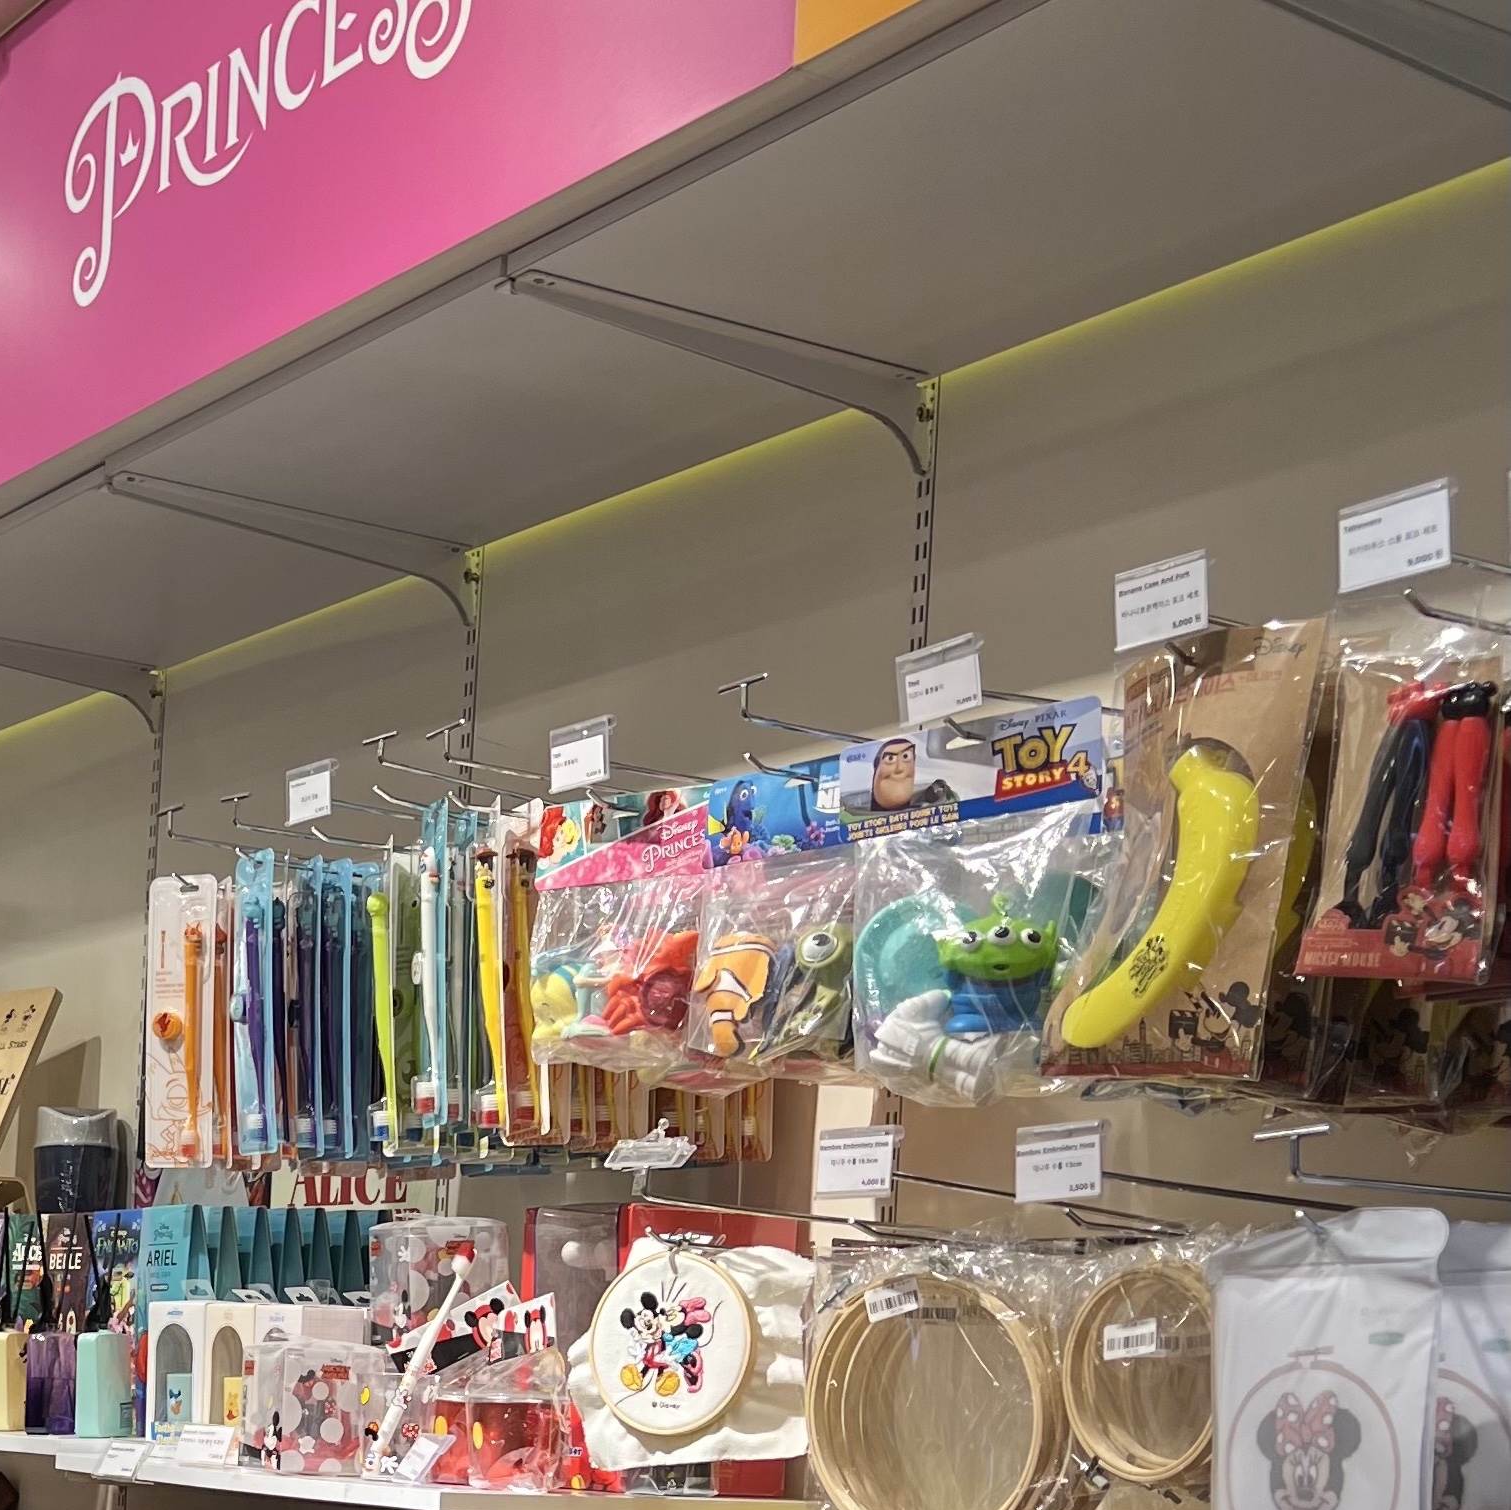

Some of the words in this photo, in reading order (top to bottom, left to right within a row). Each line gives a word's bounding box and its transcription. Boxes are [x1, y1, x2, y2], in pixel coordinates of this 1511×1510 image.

[1035, 709, 1068, 723] PIXAR
[991, 722, 1078, 773] TOY
[1001, 766, 1065, 791] STORY
[1066, 750, 1090, 776] 4
[1304, 950, 1340, 968] MICKEY
[1341, 951, 1381, 968] MOUSE
[1042, 1143, 1078, 1154] Embroidery
[146, 1249, 177, 1267] ARIEL
